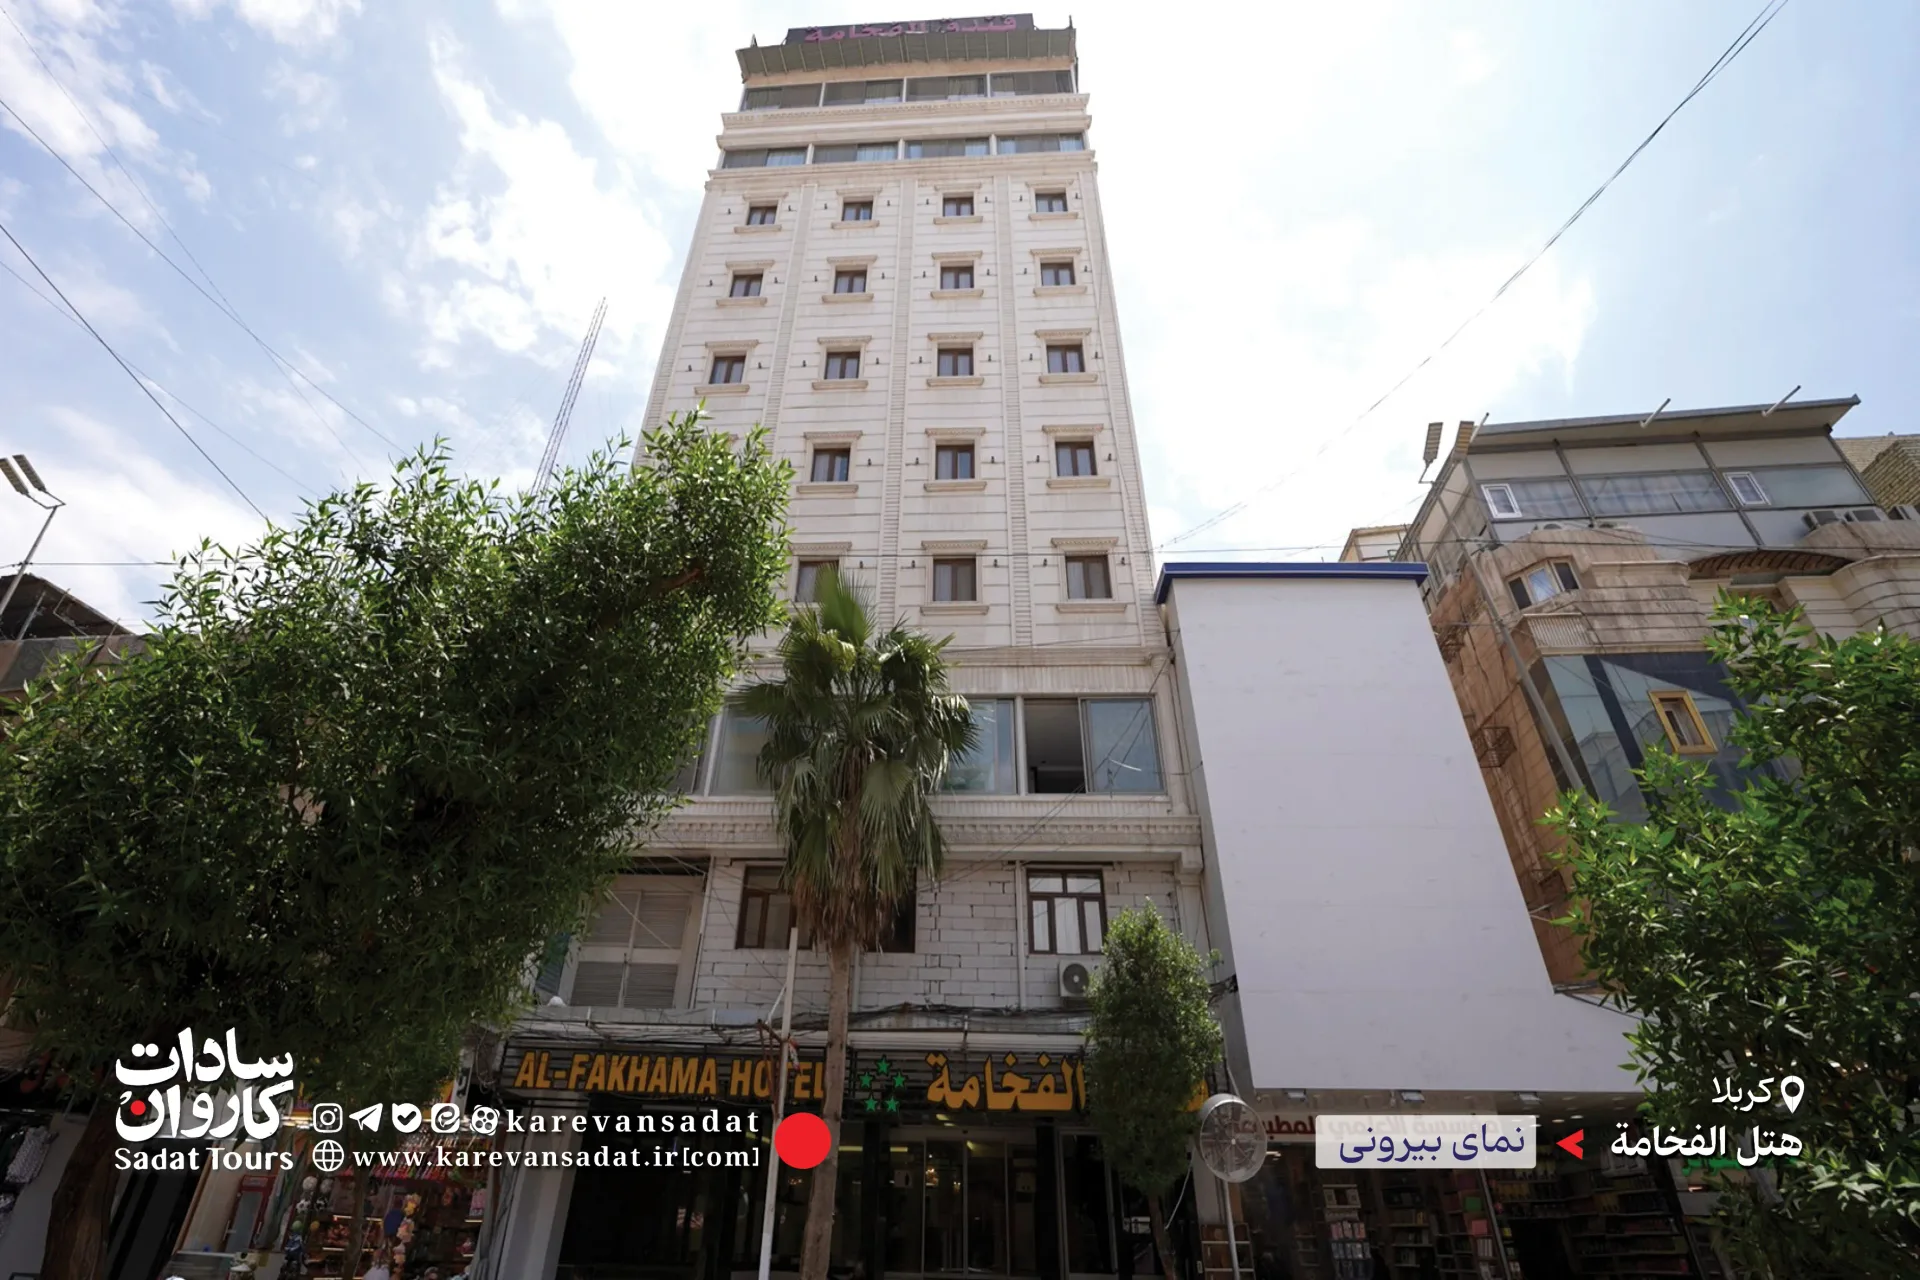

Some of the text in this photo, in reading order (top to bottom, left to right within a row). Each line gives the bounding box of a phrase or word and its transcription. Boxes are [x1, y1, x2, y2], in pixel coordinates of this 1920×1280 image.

[514, 1052, 717, 1095] AL-FAKHAMA
[730, 1059, 825, 1099] HOEL
[925, 1052, 1086, 1111] الفخامة
